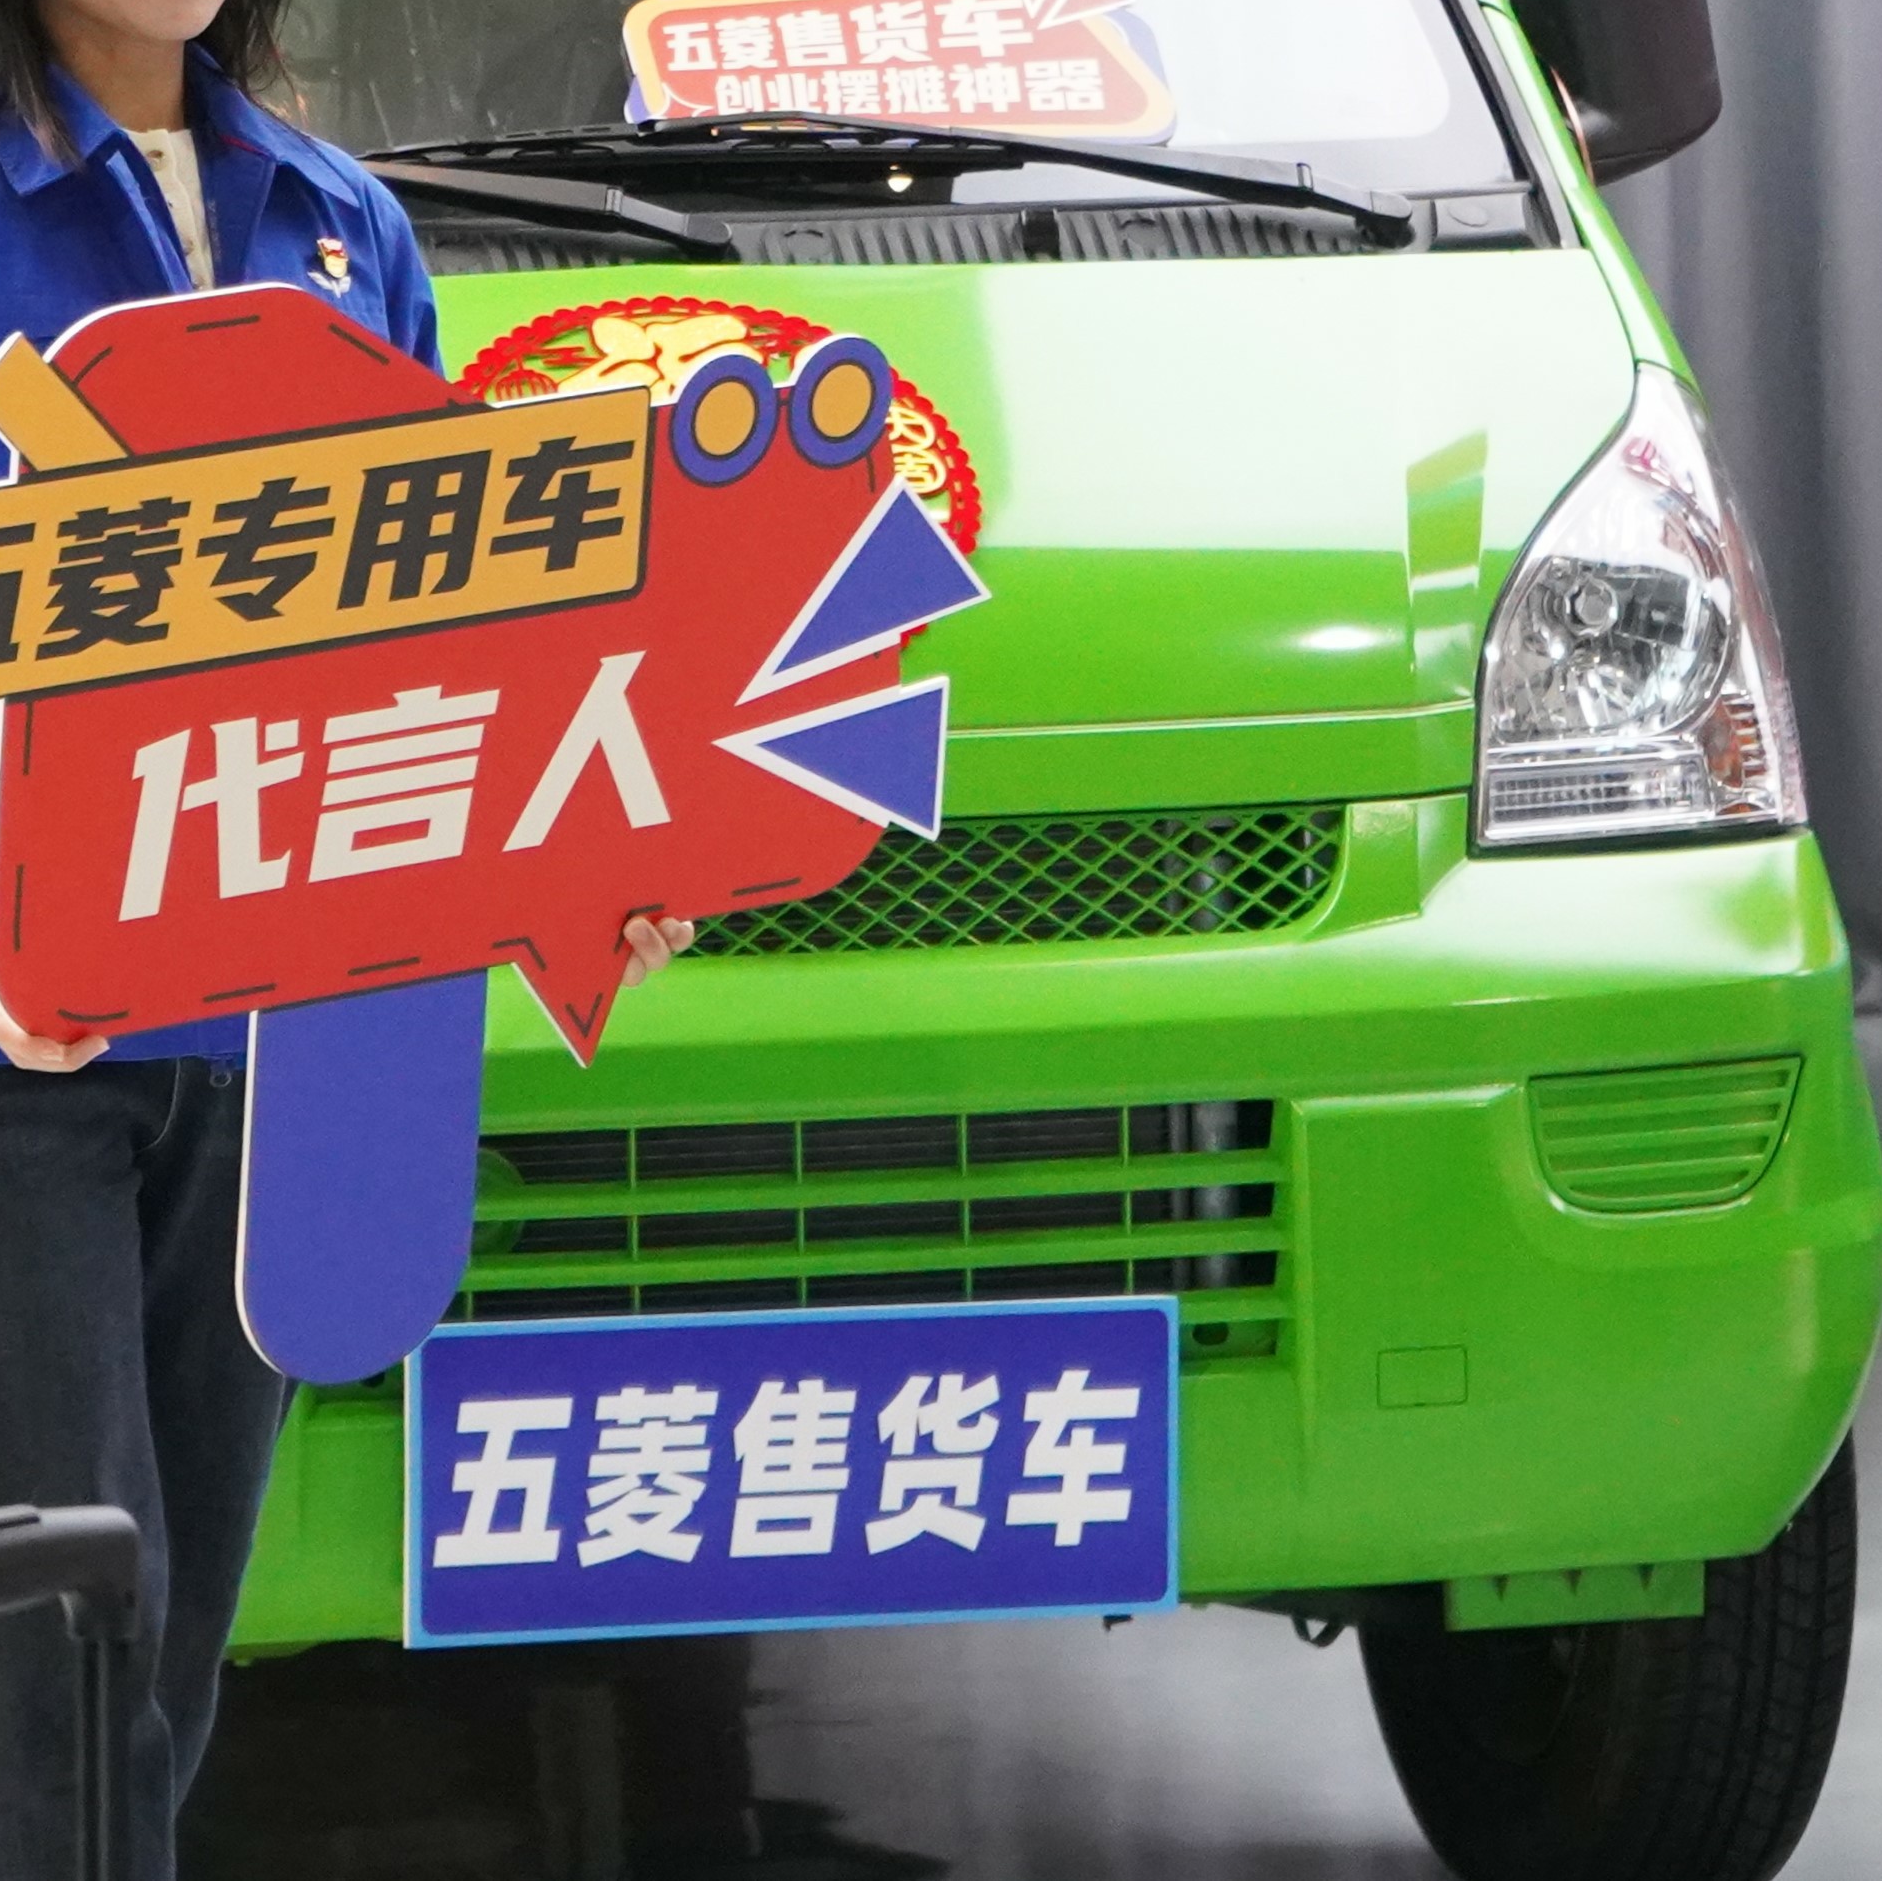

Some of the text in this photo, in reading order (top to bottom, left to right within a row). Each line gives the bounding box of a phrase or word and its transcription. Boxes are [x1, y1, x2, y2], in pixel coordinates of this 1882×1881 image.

[714, 57, 1106, 116] 创业摆摊神器
[116, 651, 672, 922] 代言人
[432, 1369, 1140, 1569] 五菱售货车
